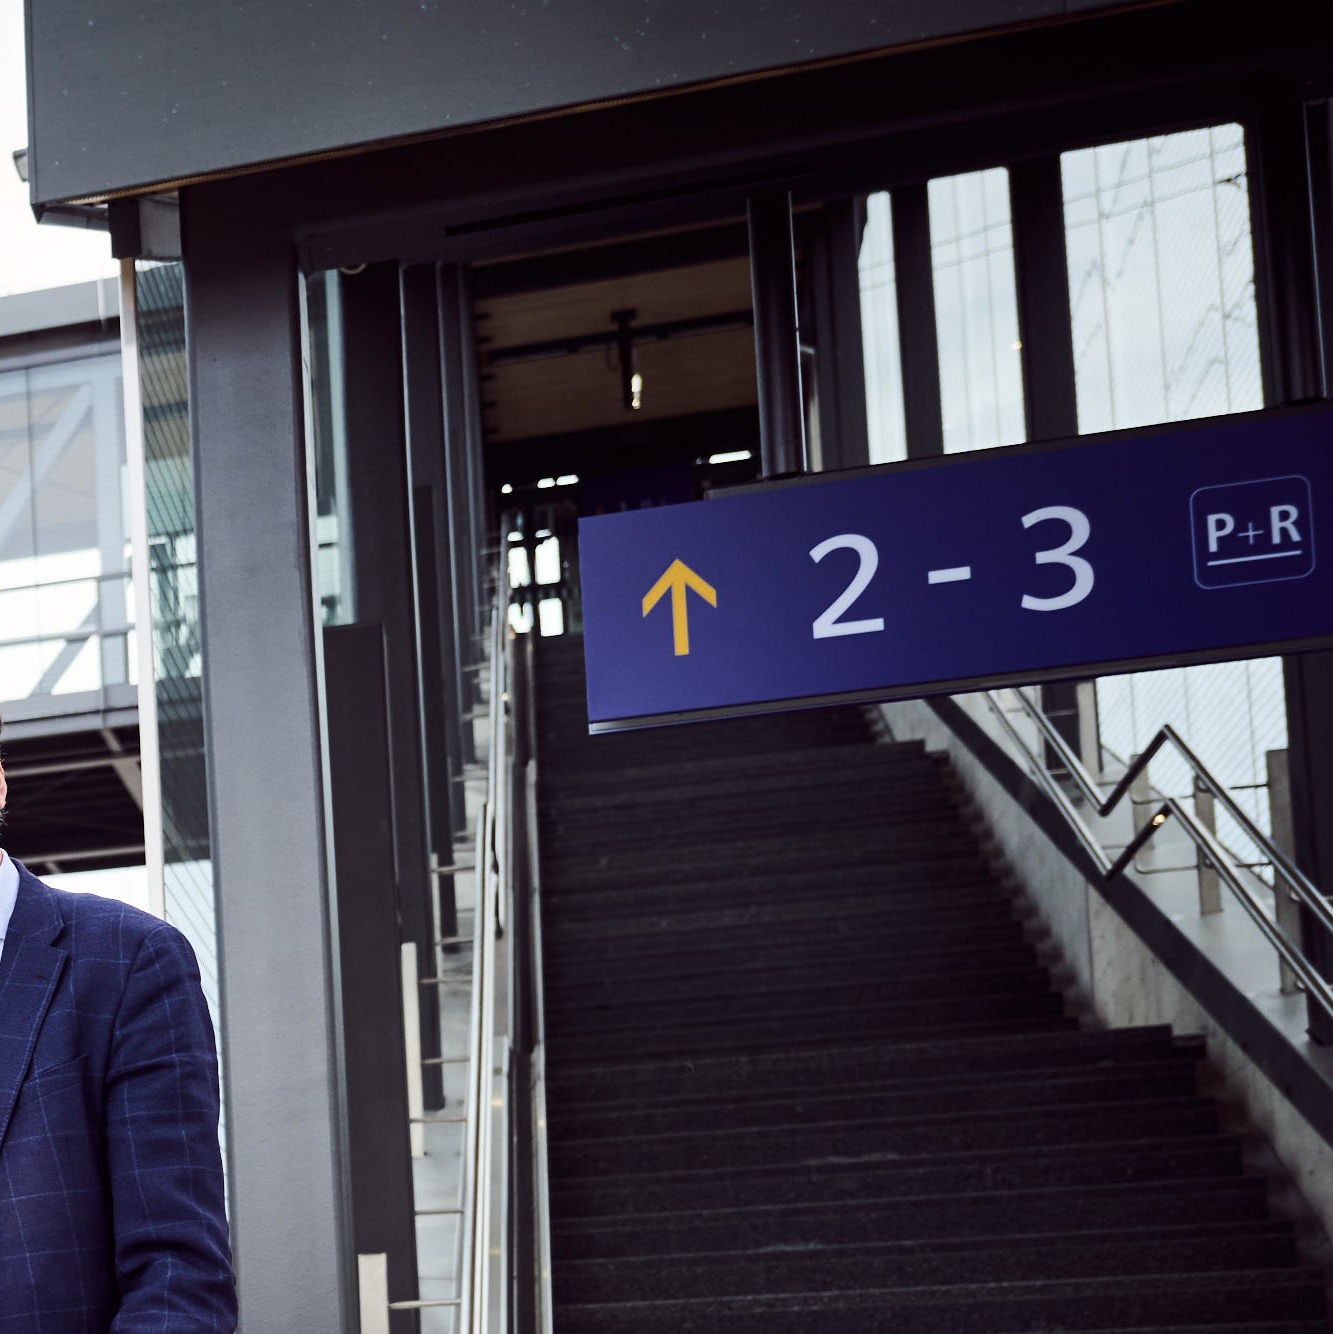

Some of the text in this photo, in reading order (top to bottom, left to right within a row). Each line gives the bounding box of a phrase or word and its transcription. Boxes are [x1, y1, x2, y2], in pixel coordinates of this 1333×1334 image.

[808, 533, 885, 640] 2
[1020, 505, 1094, 612] 3
[1207, 504, 1301, 553] P+R
